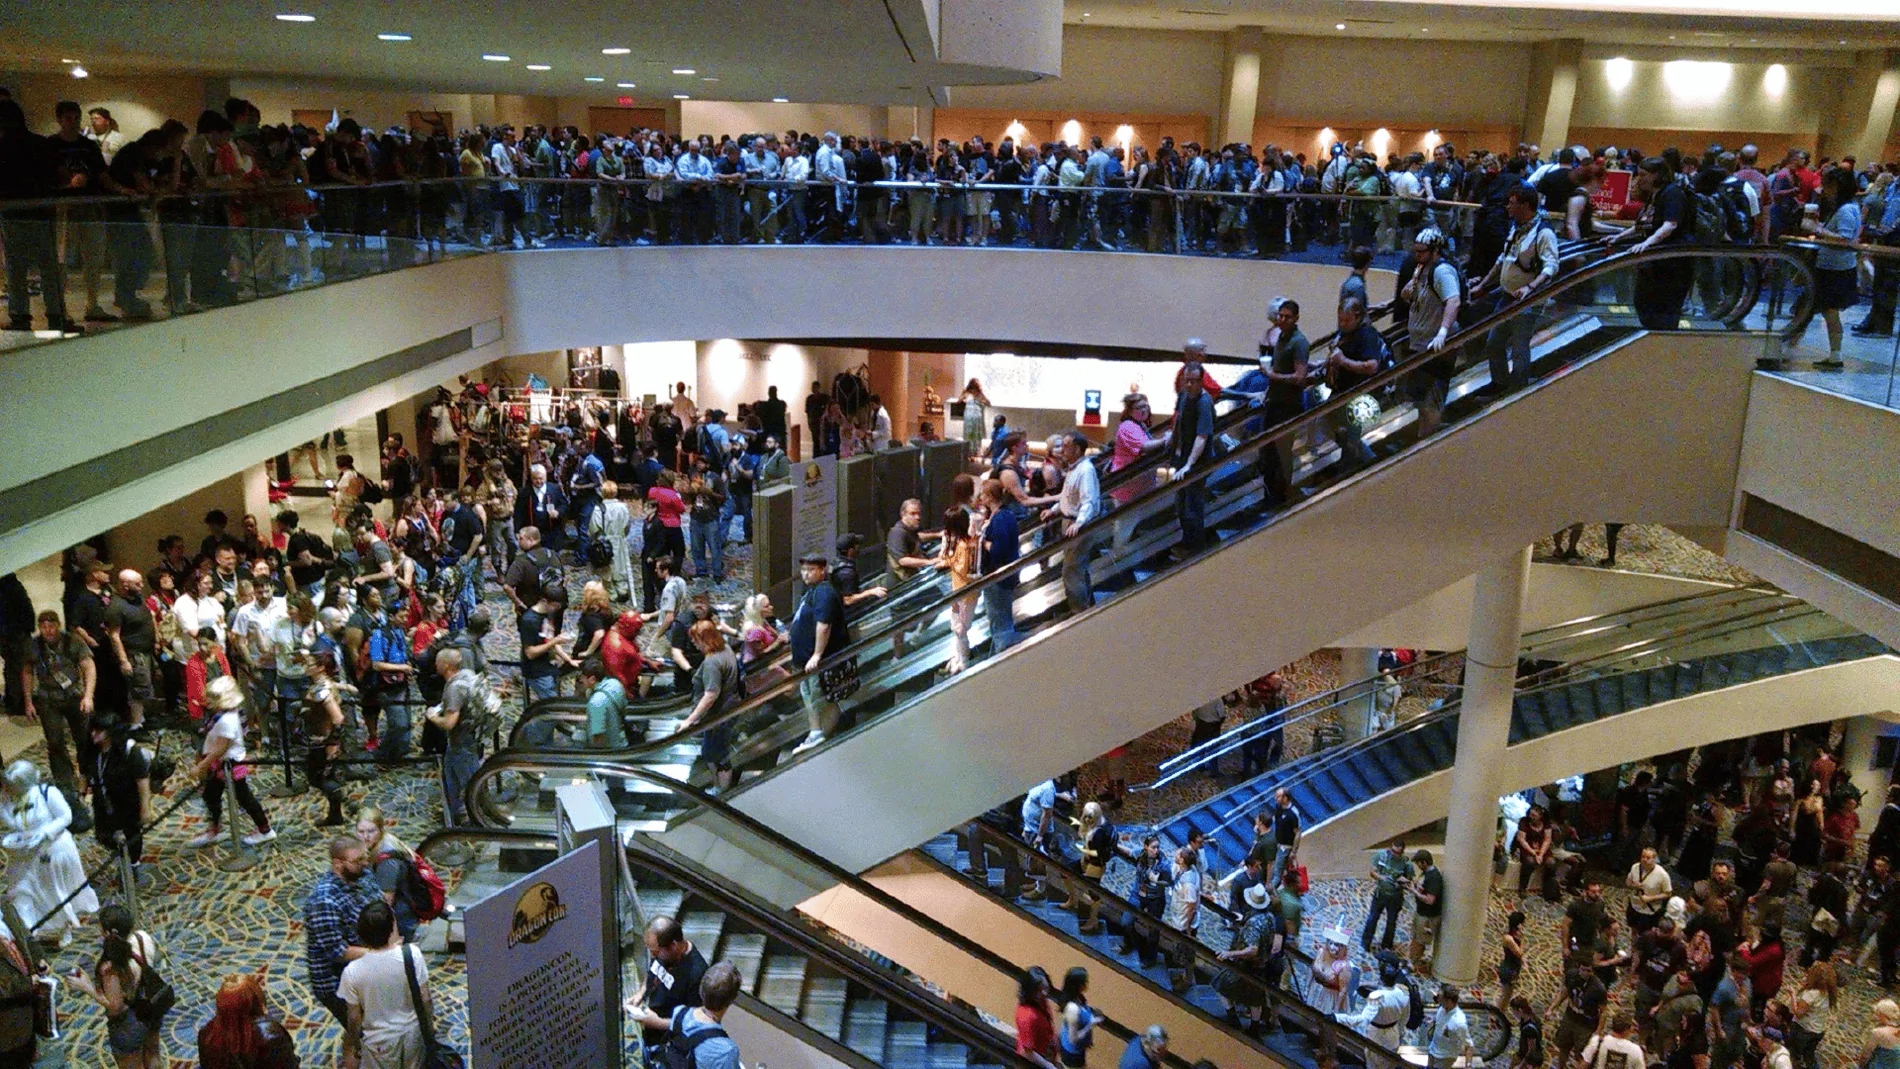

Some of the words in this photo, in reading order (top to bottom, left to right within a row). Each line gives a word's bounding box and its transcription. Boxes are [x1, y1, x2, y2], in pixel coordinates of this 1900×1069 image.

[508, 912, 547, 948] DRAGON
[548, 904, 567, 923] CON
[489, 1014, 506, 1030] FOR
[499, 1054, 522, 1069] AGON
